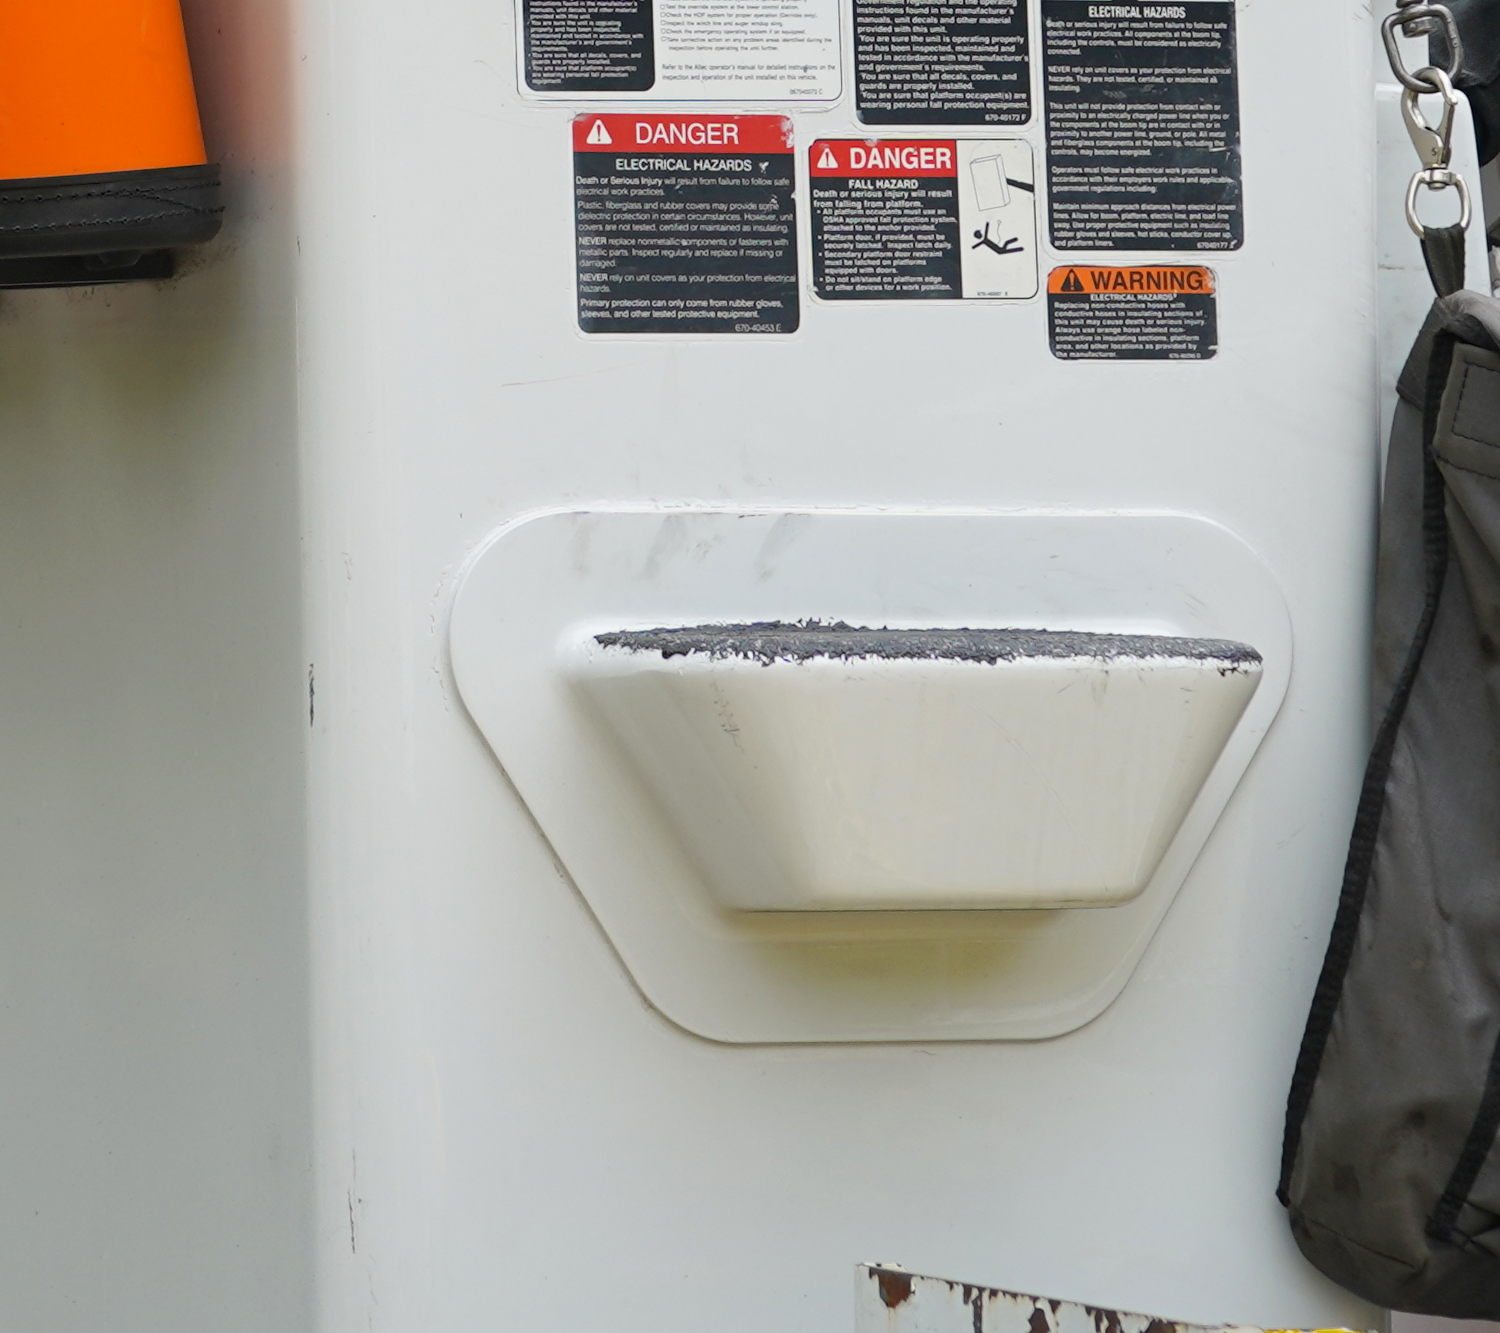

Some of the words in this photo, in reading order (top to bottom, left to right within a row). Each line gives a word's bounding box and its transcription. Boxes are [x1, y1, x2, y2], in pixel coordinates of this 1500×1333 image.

[1088, 6, 1141, 18] ELECTRICAL
[1143, 6, 1186, 18] HAZARDS
[635, 122, 739, 145] DANGER
[616, 158, 690, 171] ELECTRICAL
[693, 159, 752, 171] HAZARDS
[850, 147, 951, 169] DANGER
[848, 179, 873, 189] FALL
[876, 179, 919, 189] HAZARD
[1090, 271, 1204, 290] WARNING
[1090, 293, 1136, 301] ELECTRICAL
